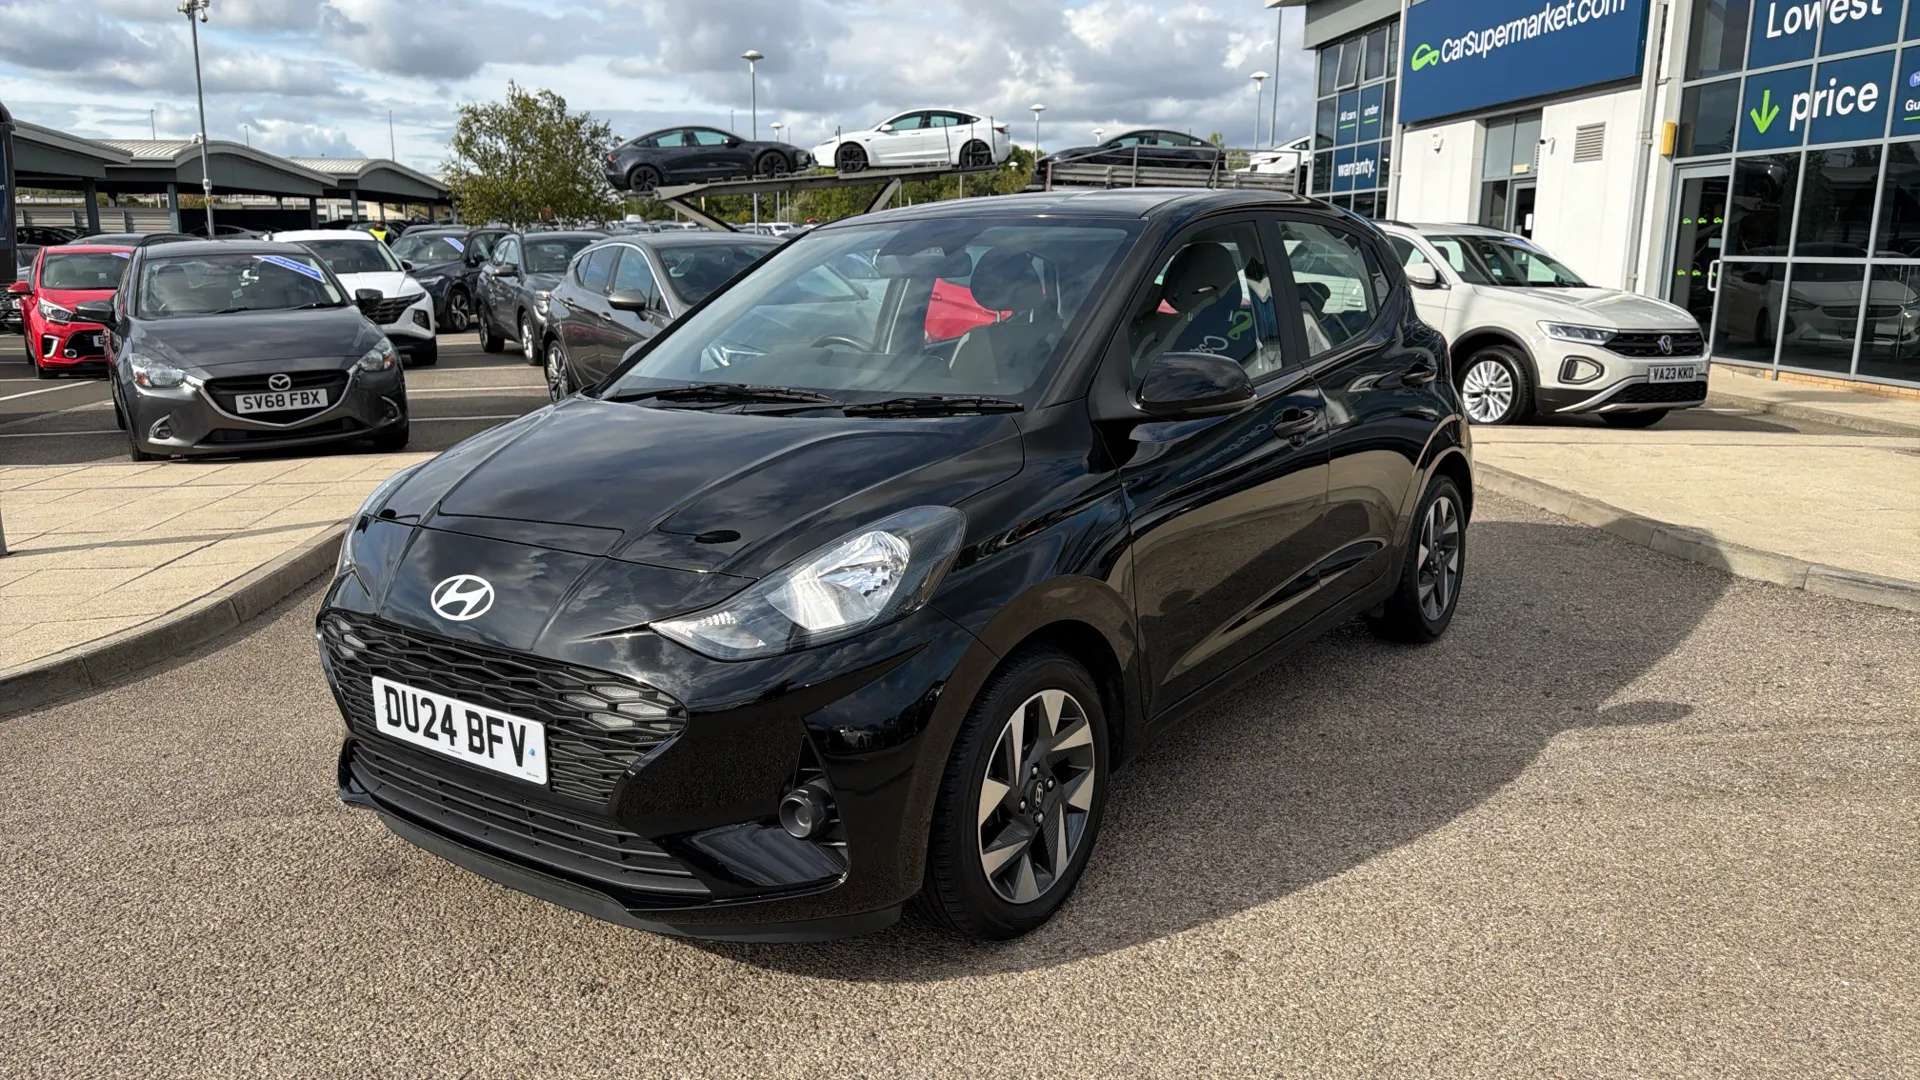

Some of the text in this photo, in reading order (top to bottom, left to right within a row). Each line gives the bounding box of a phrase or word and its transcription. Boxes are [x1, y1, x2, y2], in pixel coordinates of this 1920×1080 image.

[1442, 0, 1625, 63] CarSupermarket.com
[1789, 77, 1879, 131] price
[243, 391, 321, 410] SV68 FBX
[1653, 367, 1677, 380] VA23
[384, 685, 526, 767] DU24 BFV
